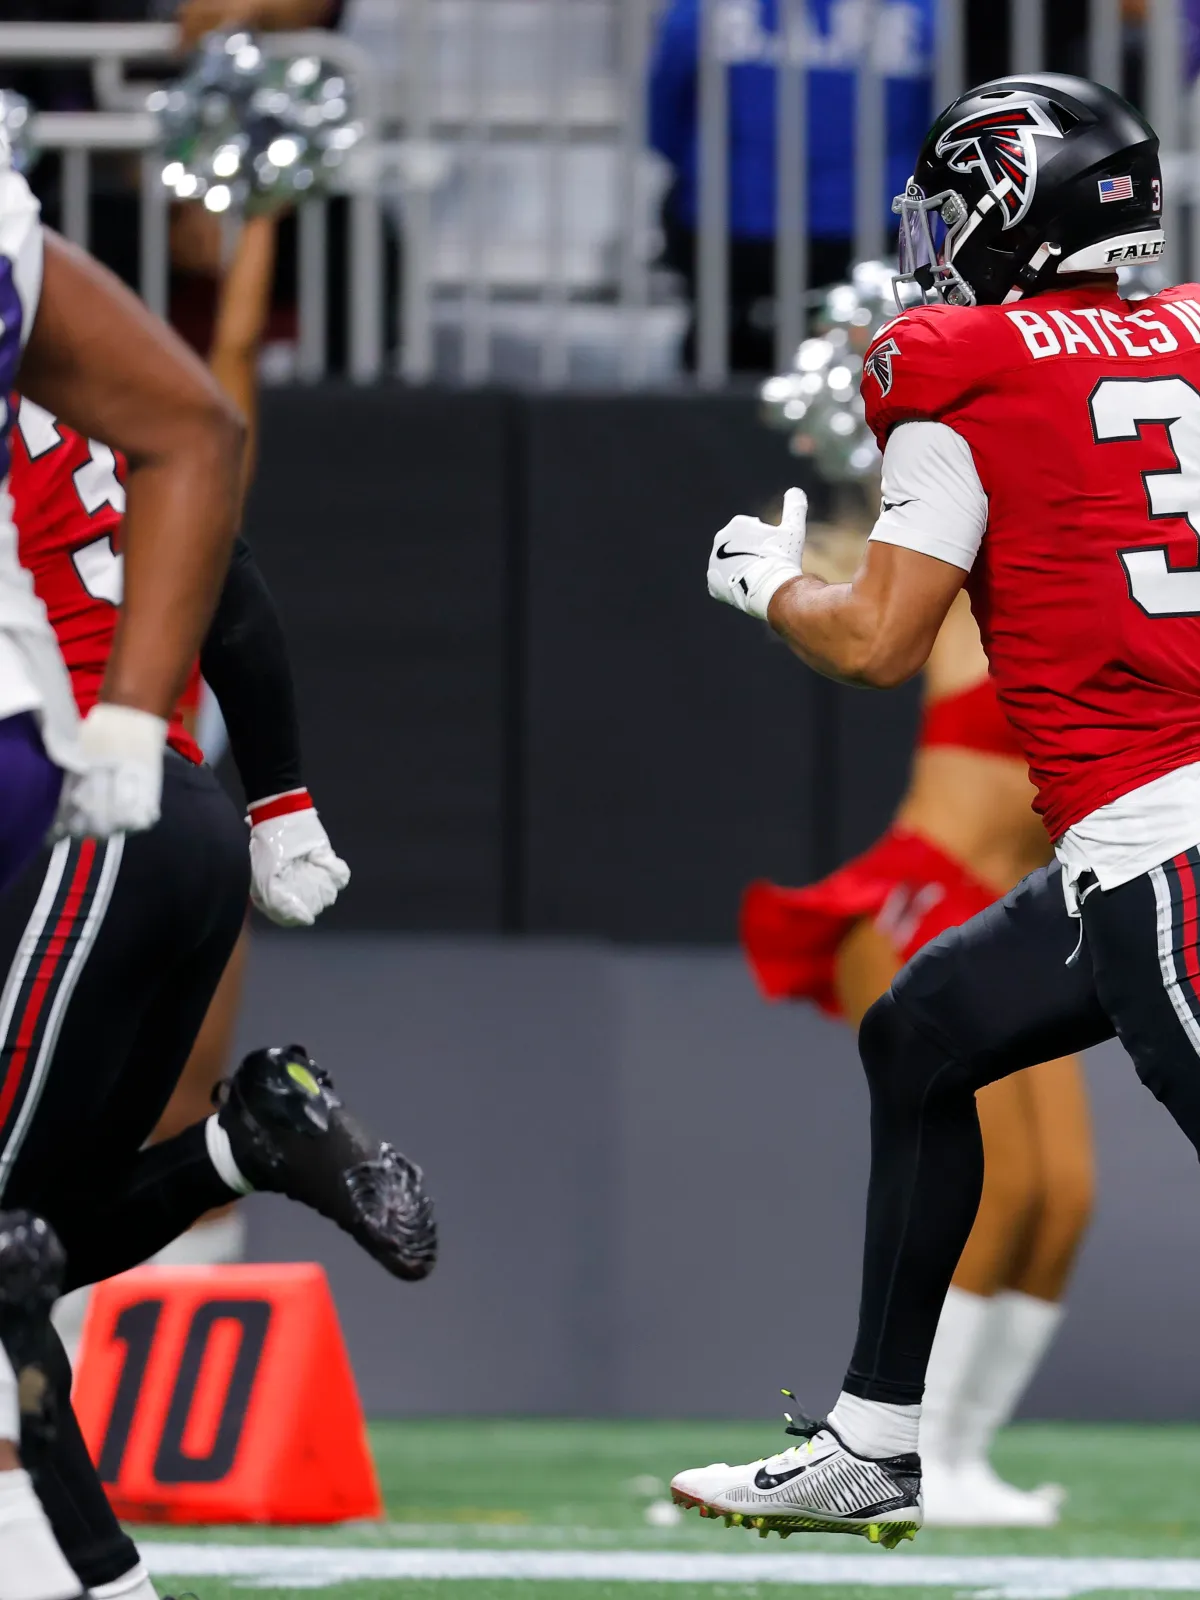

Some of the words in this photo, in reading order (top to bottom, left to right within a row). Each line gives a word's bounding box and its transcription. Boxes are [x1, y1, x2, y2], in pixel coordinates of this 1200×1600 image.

[1151, 178, 1161, 212] 3
[1005, 308, 1178, 359] BATES
[97, 1299, 272, 1485] 10
